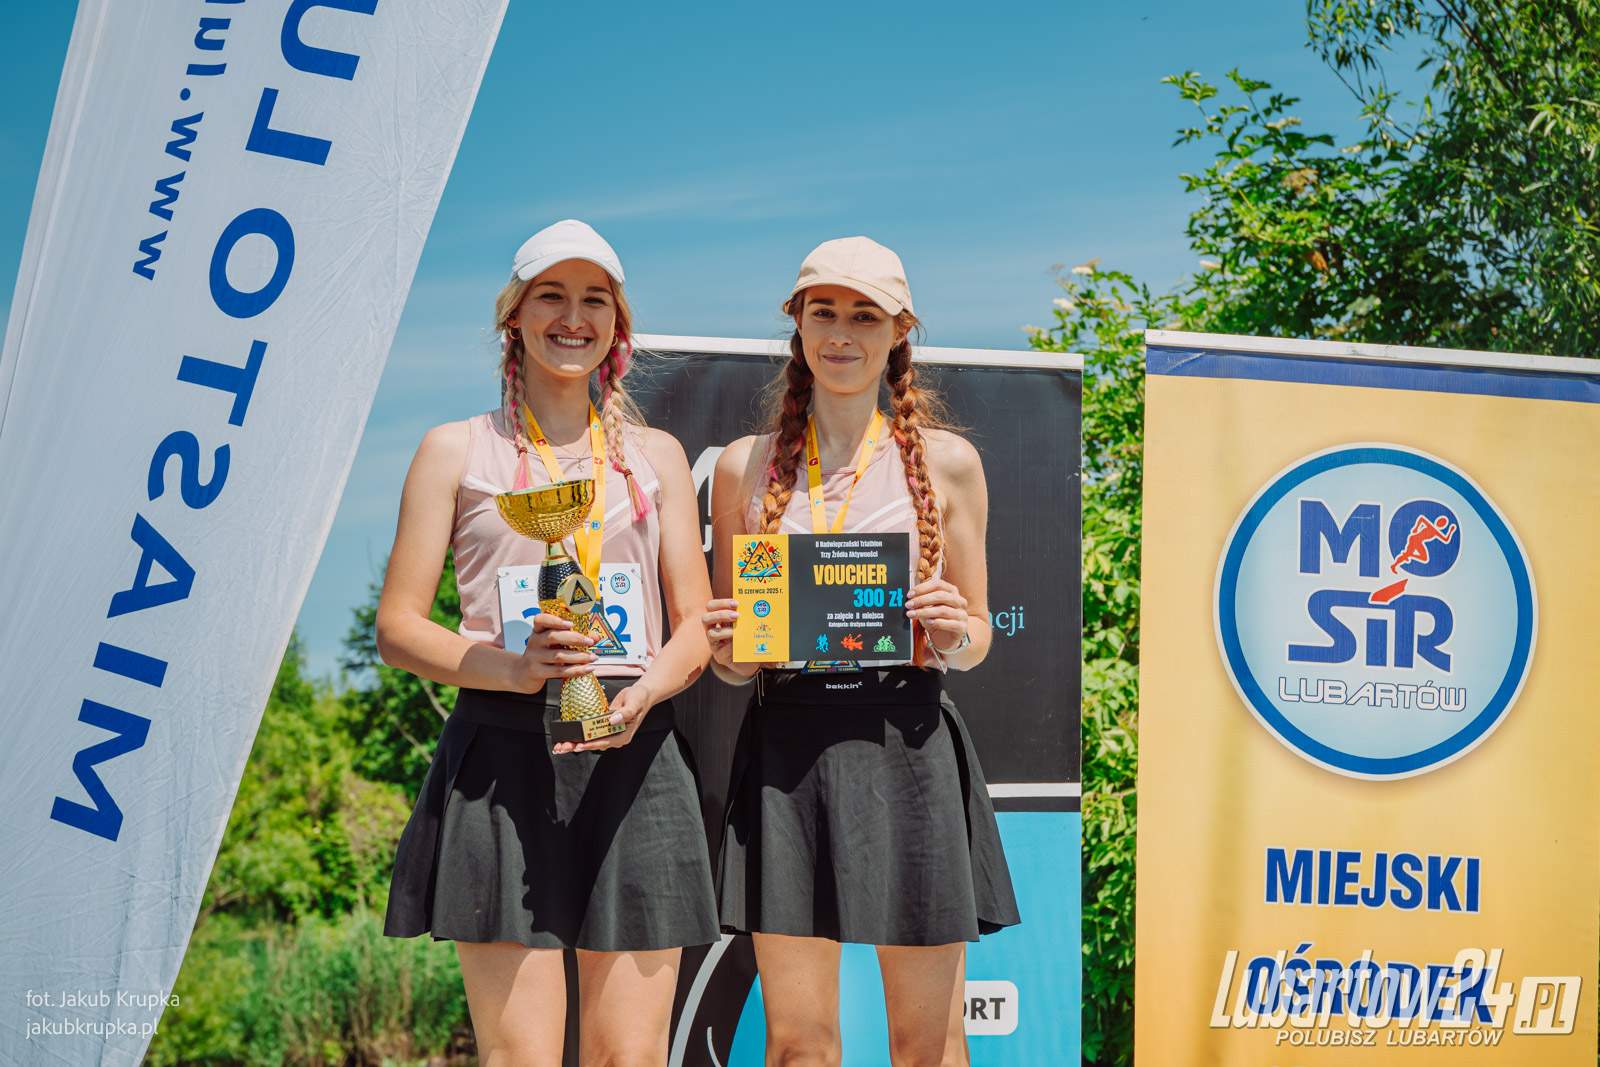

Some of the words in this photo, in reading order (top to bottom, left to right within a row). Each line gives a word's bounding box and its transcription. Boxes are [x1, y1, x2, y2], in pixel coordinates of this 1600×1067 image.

[1299, 500, 1461, 578] MO
[813, 564, 888, 586] VOUCHER
[853, 587, 885, 608] 300
[888, 587, 904, 608] zł
[1278, 676, 1468, 713] LUBARTÓW
[1264, 847, 1481, 912] MIEJSKI
[1245, 942, 1494, 1025] OŚRODEK
[963, 997, 1006, 1020] RT
